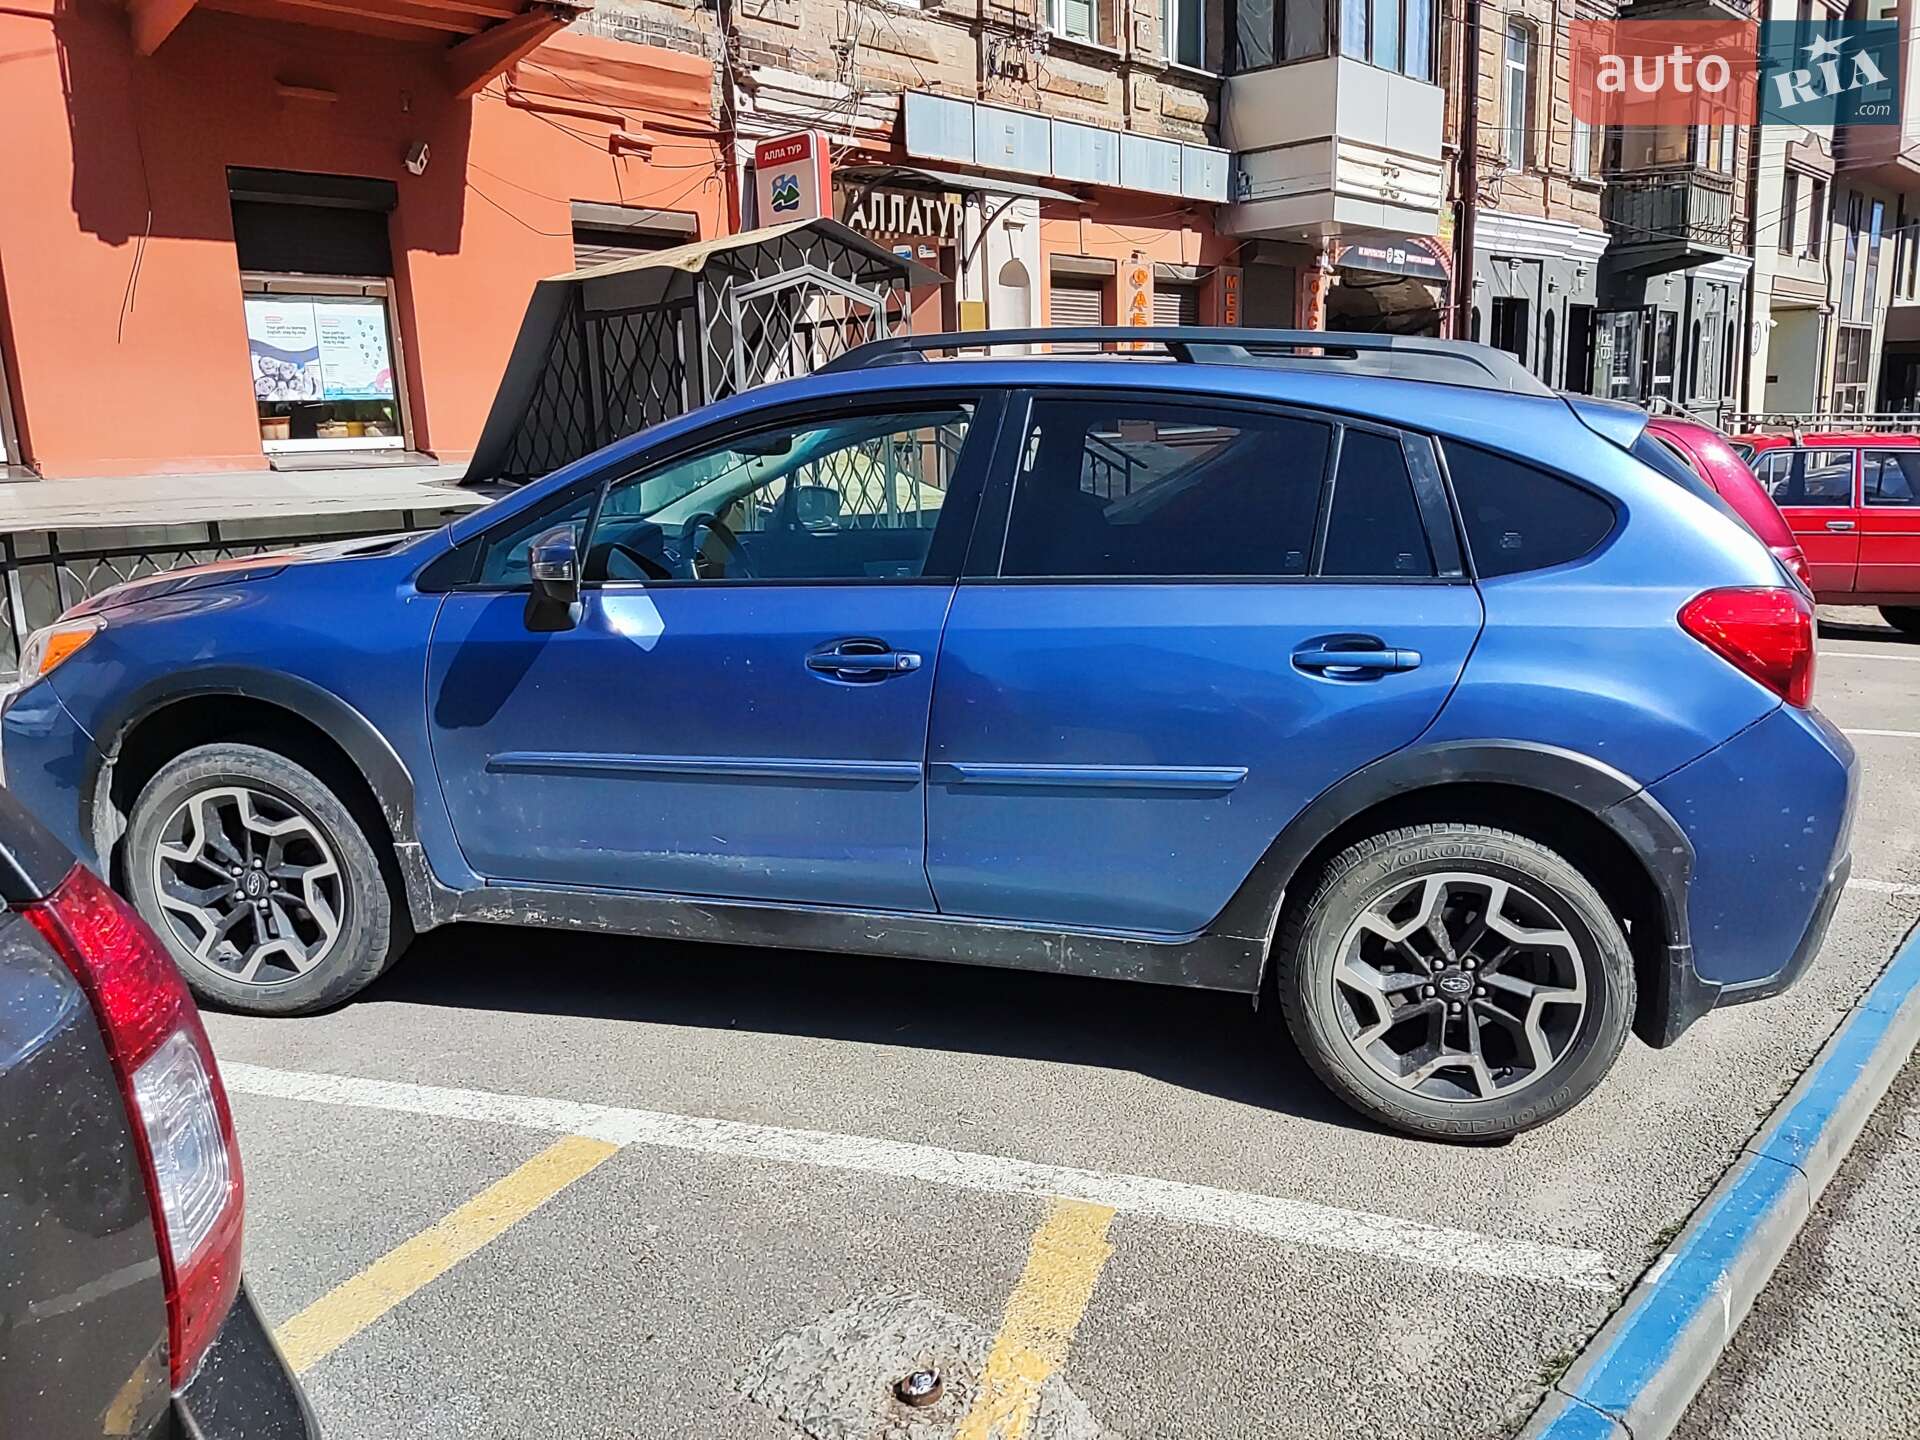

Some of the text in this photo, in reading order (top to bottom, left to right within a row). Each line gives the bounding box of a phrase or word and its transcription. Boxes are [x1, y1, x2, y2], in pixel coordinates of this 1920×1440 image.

[764, 143, 802, 161] АЛЛА ТУР
[848, 191, 965, 239] АЛЛАТУР
